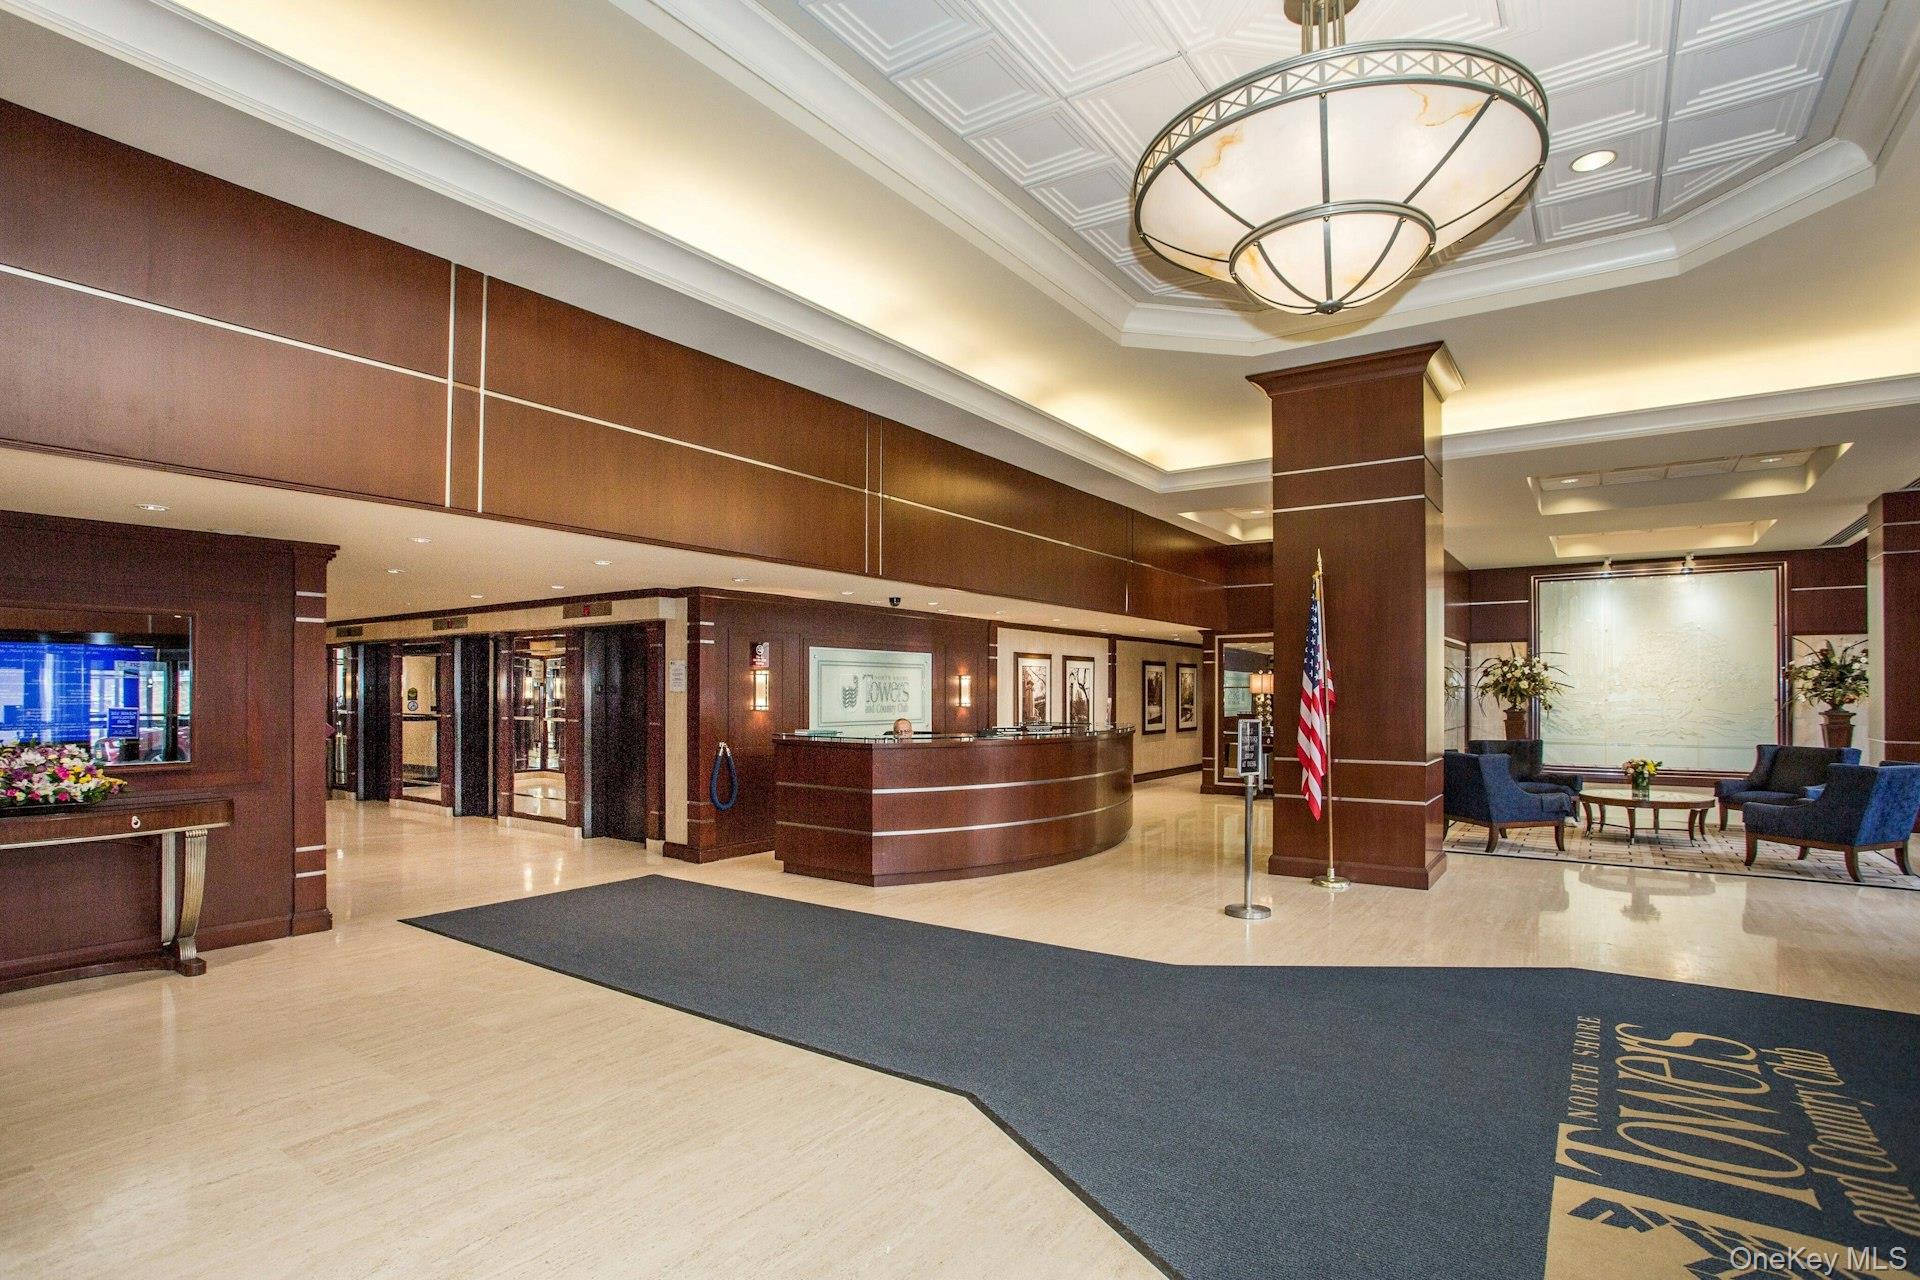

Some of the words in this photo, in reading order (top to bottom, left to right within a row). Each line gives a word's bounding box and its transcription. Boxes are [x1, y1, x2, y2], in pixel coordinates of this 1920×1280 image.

[862, 674, 910, 703] Towers
[1573, 1016, 1601, 1058] SHORE
[1760, 1047, 1845, 1085] Club
[1567, 1063, 1599, 1122] NORTH
[1555, 1022, 1822, 1211] Towers
